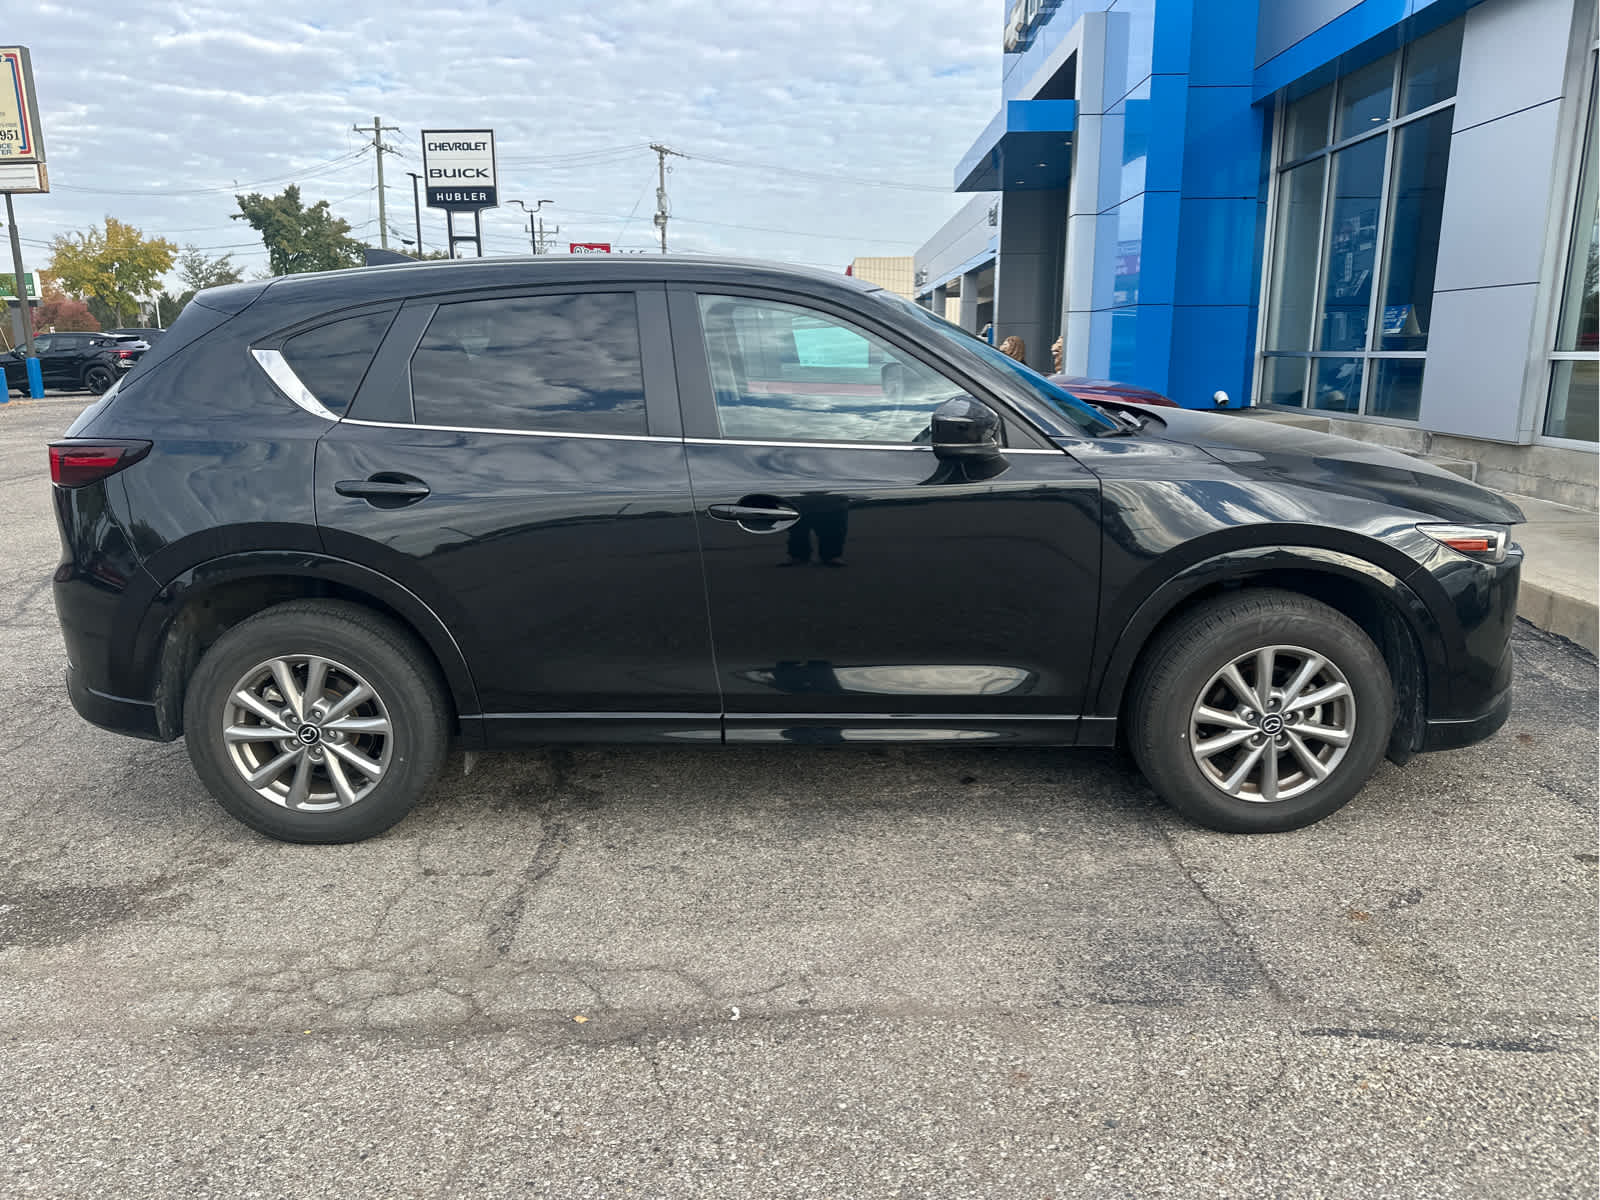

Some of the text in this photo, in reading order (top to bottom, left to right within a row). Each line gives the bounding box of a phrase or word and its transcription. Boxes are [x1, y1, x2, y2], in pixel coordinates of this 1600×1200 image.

[428, 142, 488, 151] CHEVROLET
[429, 168, 490, 178] BUICK
[436, 192, 487, 201] HUBLER
